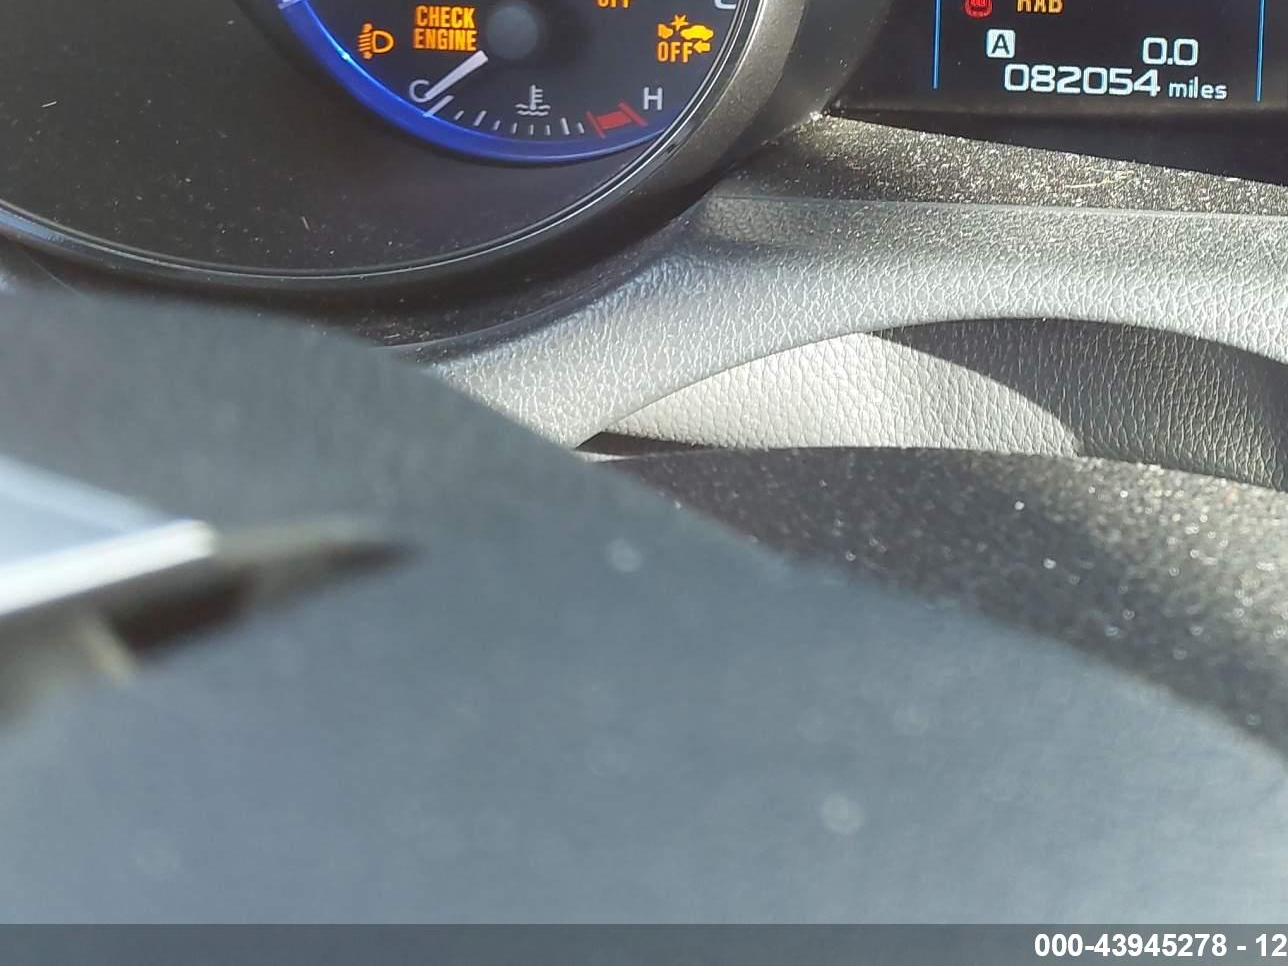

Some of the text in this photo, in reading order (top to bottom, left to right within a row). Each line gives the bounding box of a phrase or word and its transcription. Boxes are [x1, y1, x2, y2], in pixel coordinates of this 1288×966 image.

[414, 5, 475, 30] CHECK
[414, 28, 477, 51] ENGINE
[658, 42, 694, 62] OFF
[1143, 37, 1198, 66] 0.0
[410, 80, 431, 102] C
[1004, 64, 1227, 99] 082054 miles
[644, 88, 663, 109] H
